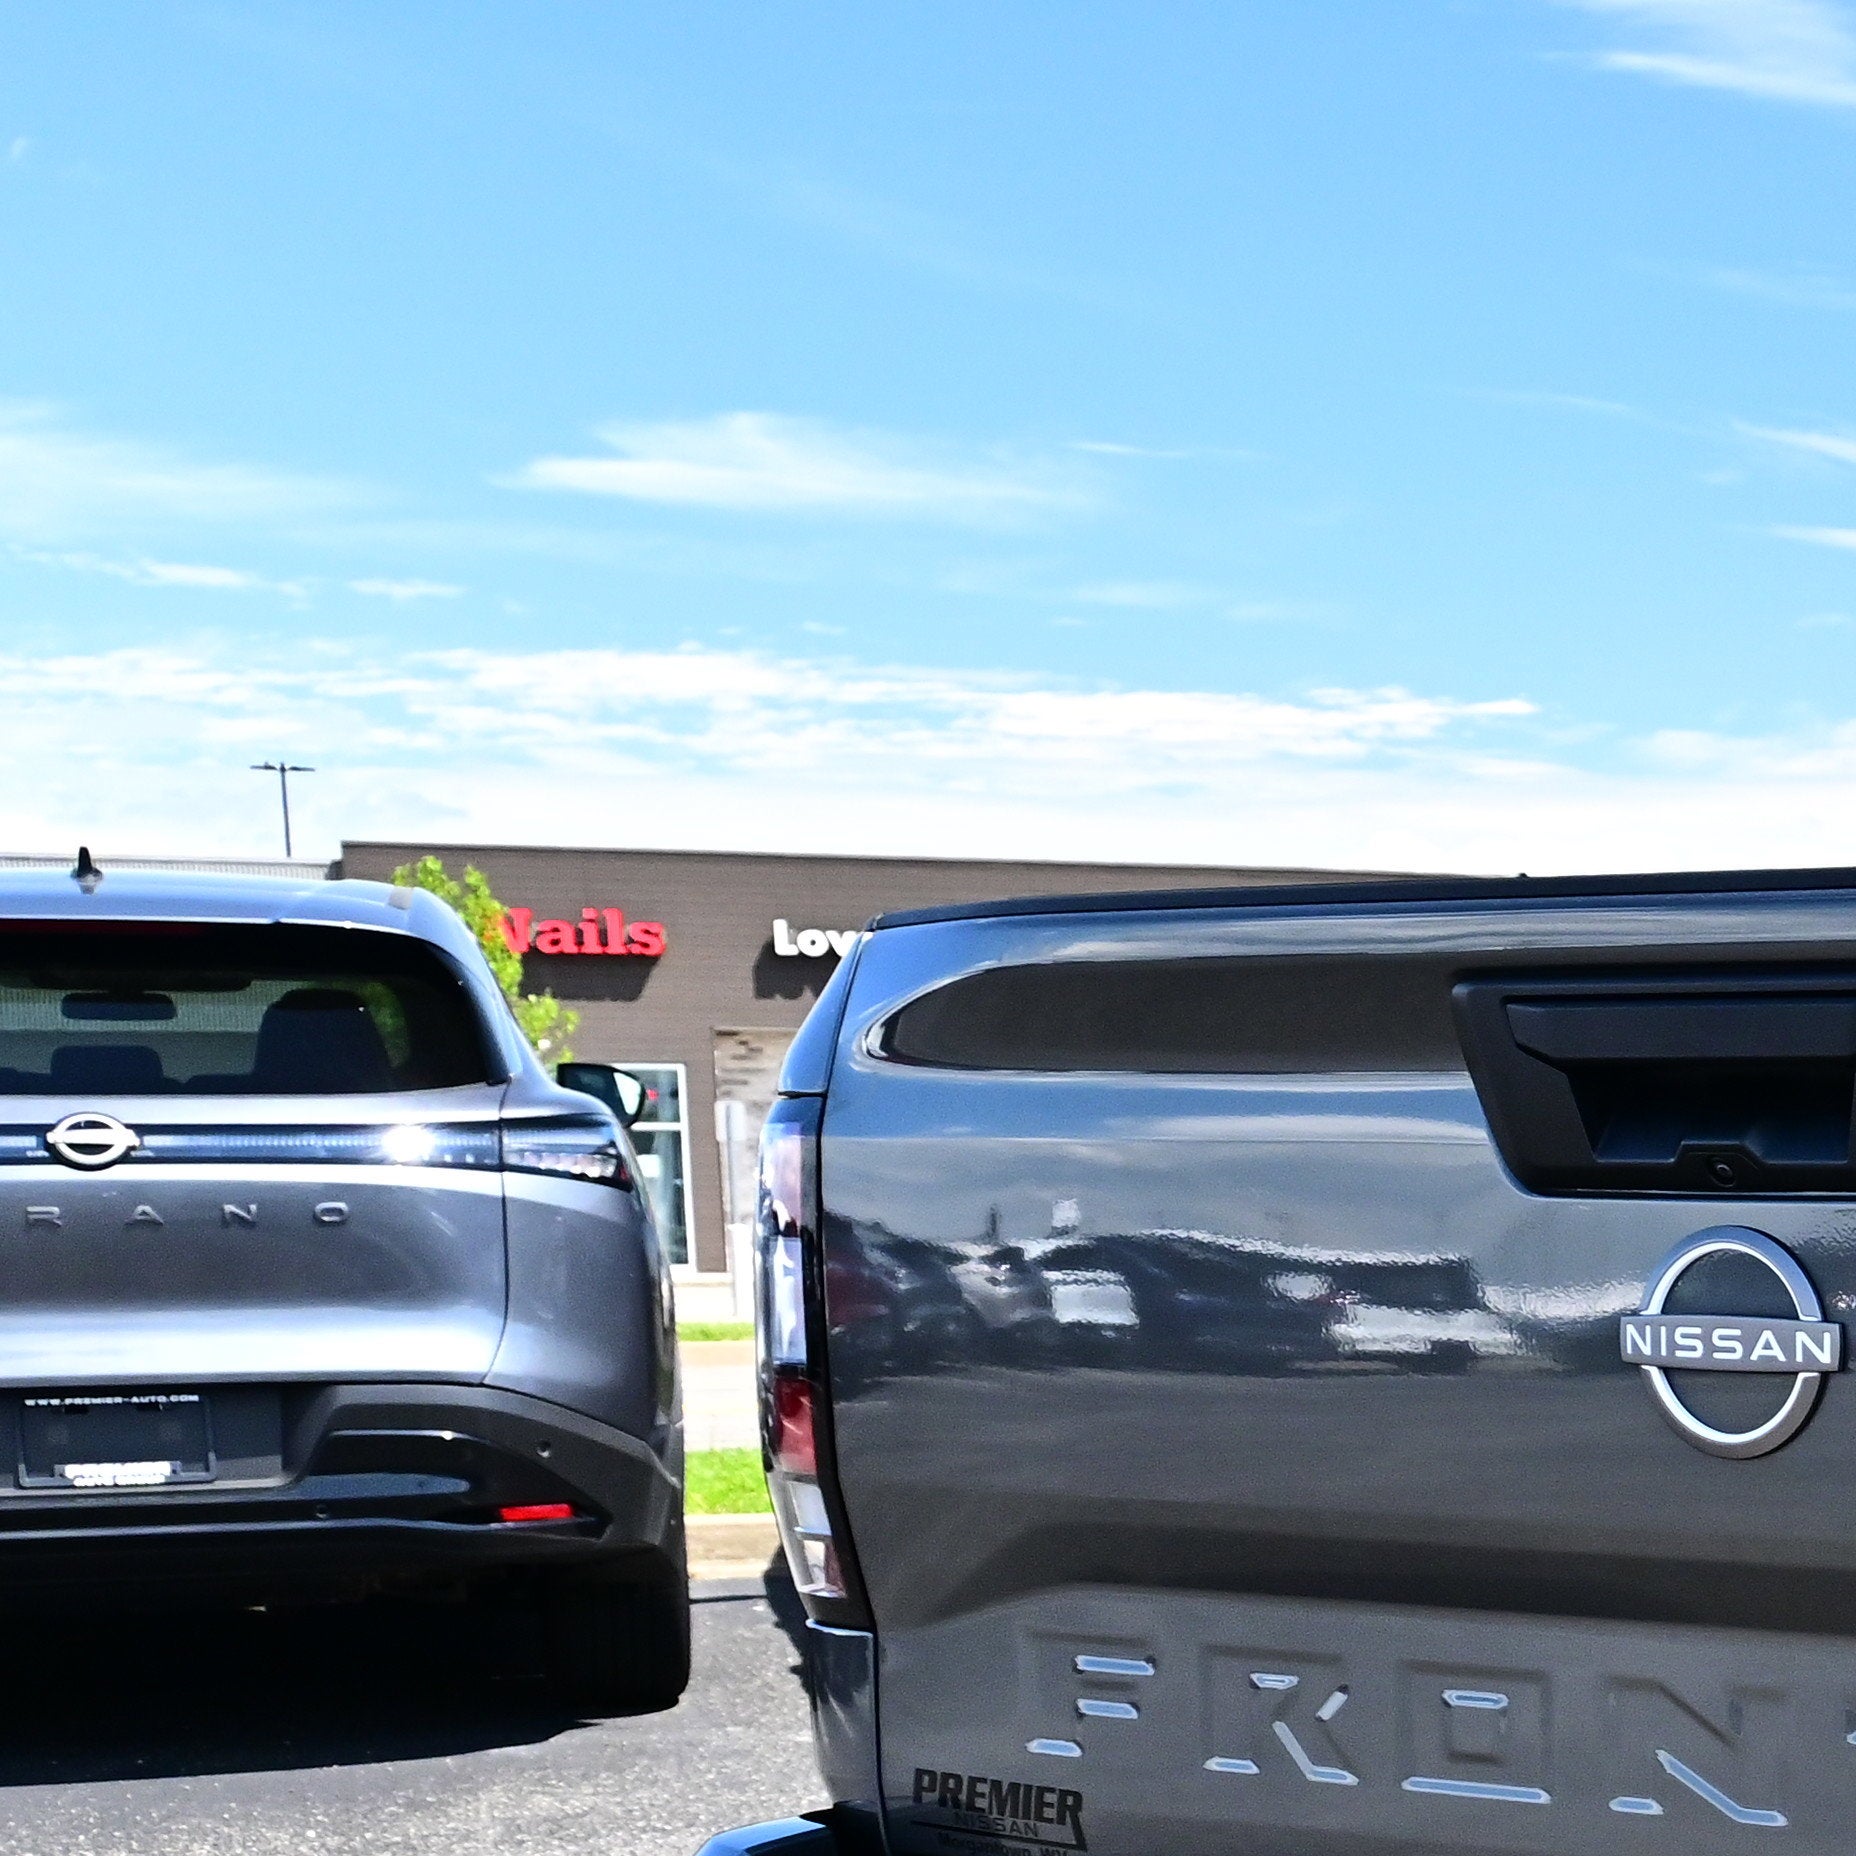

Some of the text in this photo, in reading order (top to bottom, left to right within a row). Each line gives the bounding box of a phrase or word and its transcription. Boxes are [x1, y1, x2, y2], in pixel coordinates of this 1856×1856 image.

[499, 907, 666, 956] Nails
[1624, 1323, 1832, 1365] NISSAN
[912, 1768, 1086, 1840] PREMIER
[953, 1811, 1039, 1838] NISSAN
